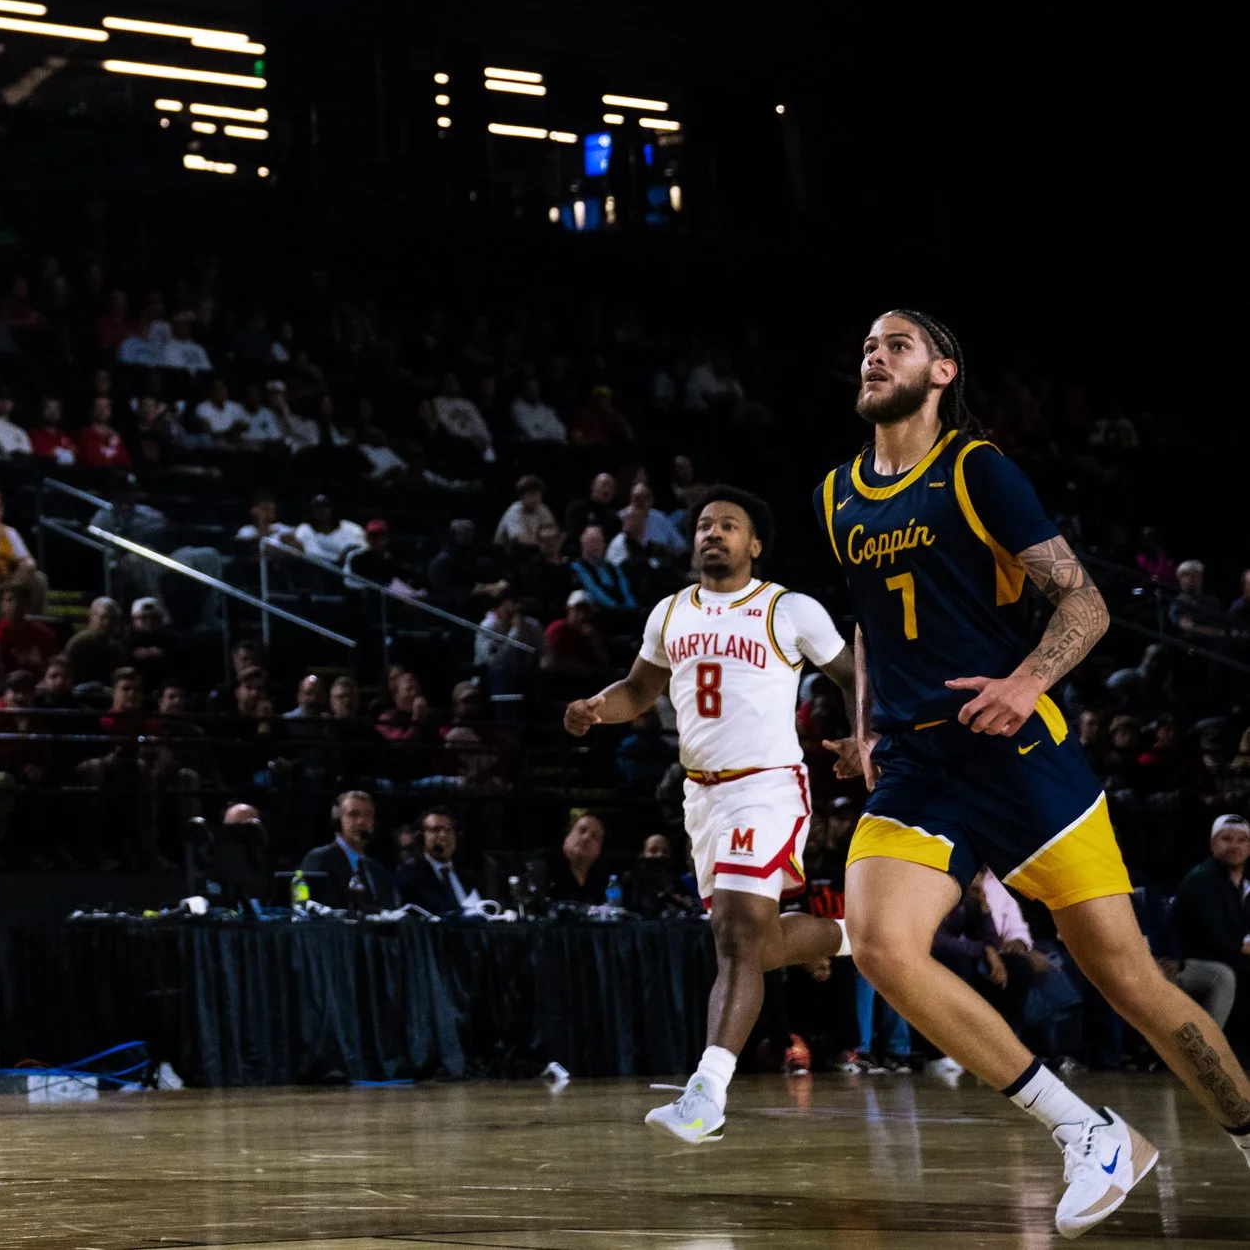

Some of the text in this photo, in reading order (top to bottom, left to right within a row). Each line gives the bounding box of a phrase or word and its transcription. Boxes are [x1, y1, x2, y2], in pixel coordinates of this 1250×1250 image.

[848, 518, 936, 568] Coppin
[885, 571, 918, 640] 7
[668, 633, 767, 670] MARYLAND
[696, 662, 722, 718] 8
[730, 827, 756, 852] M
